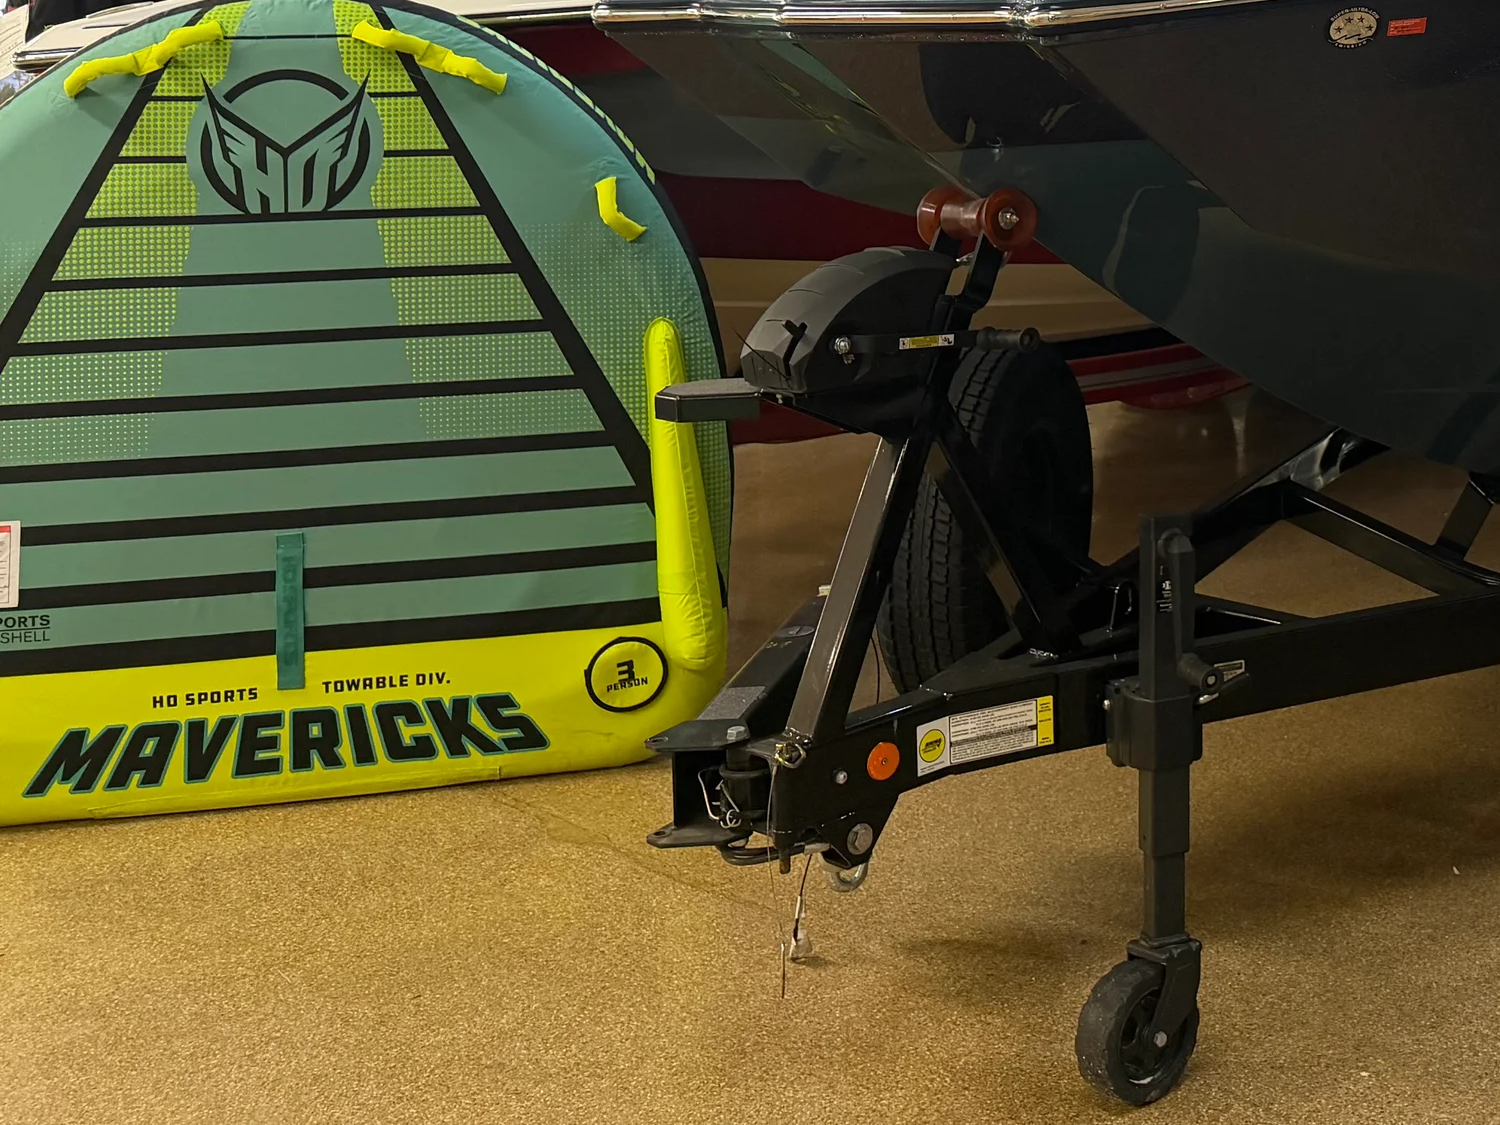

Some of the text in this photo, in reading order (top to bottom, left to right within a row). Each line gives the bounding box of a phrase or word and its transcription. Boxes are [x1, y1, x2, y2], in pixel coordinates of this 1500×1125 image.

[322, 671, 452, 694] TOWABLE DIV.
[616, 659, 636, 684] 3
[606, 677, 649, 693] PERSON
[152, 686, 259, 709] HO SPORTS
[21, 692, 552, 798] MAVERICKS
